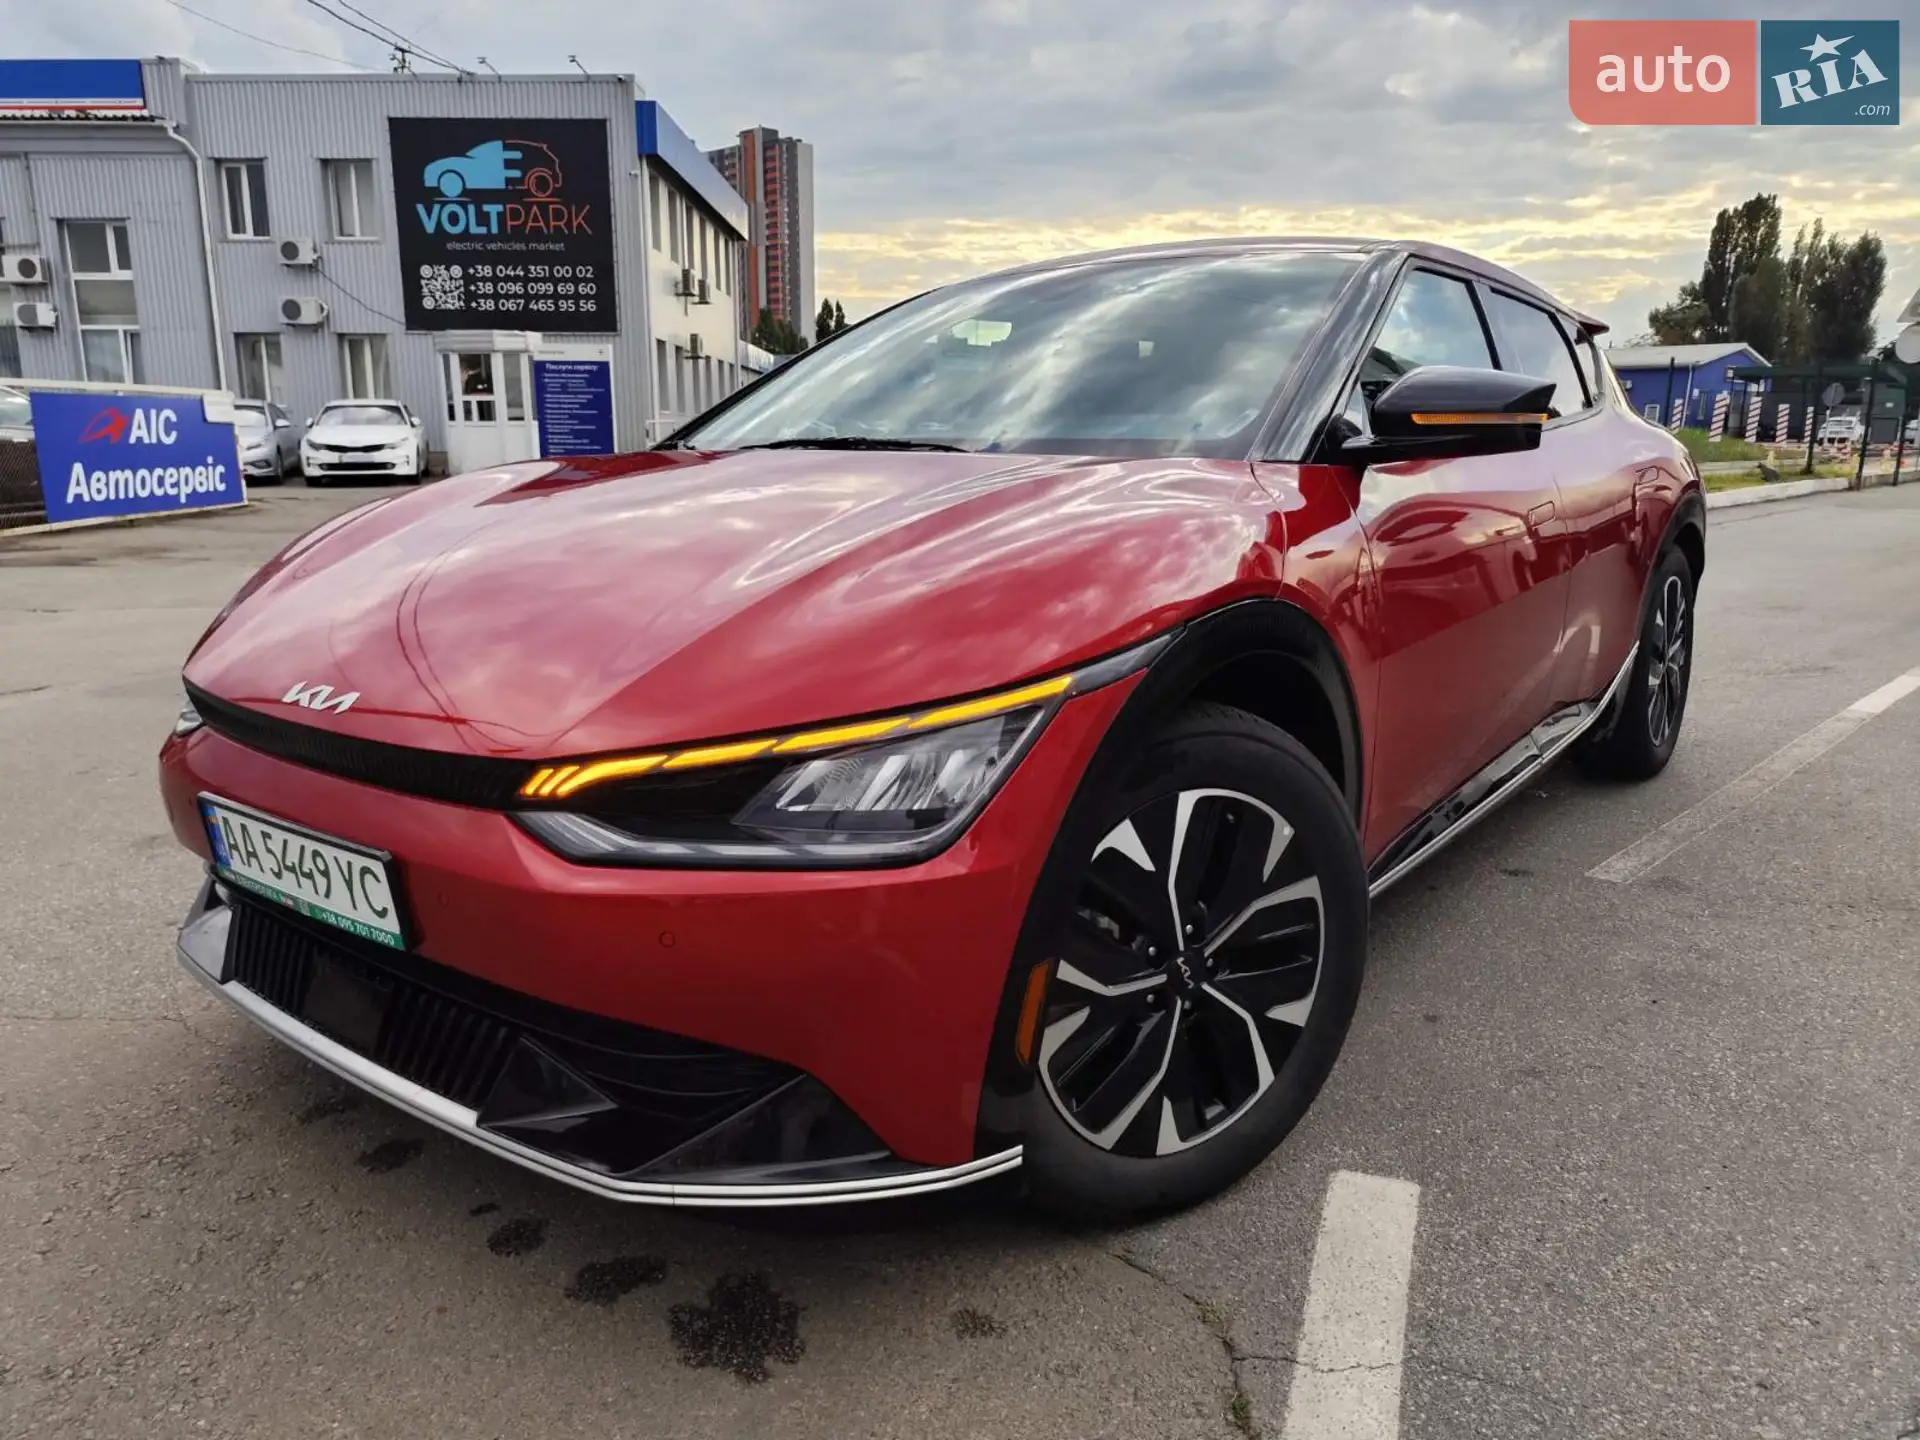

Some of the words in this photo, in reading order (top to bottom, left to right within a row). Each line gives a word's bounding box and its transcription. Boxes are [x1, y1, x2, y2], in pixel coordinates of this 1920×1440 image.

[446, 241, 483, 251] electric
[486, 241, 526, 251] vehicles
[529, 241, 565, 251] market
[467, 265, 492, 278] +38
[496, 265, 524, 278] 044
[528, 265, 549, 278] 351
[553, 265, 572, 278] 00
[576, 265, 594, 278] 02
[469, 283, 494, 295] +38
[497, 283, 524, 295] 096
[527, 283, 553, 295] 099
[557, 283, 575, 295] 69
[578, 283, 596, 295] 60
[470, 299, 495, 312] +38
[499, 299, 524, 312] 067
[529, 299, 555, 312] 465
[558, 299, 576, 312] 95
[579, 299, 597, 312] 56
[65, 455, 227, 504] Автосервіс
[282, 680, 361, 715] KIA
